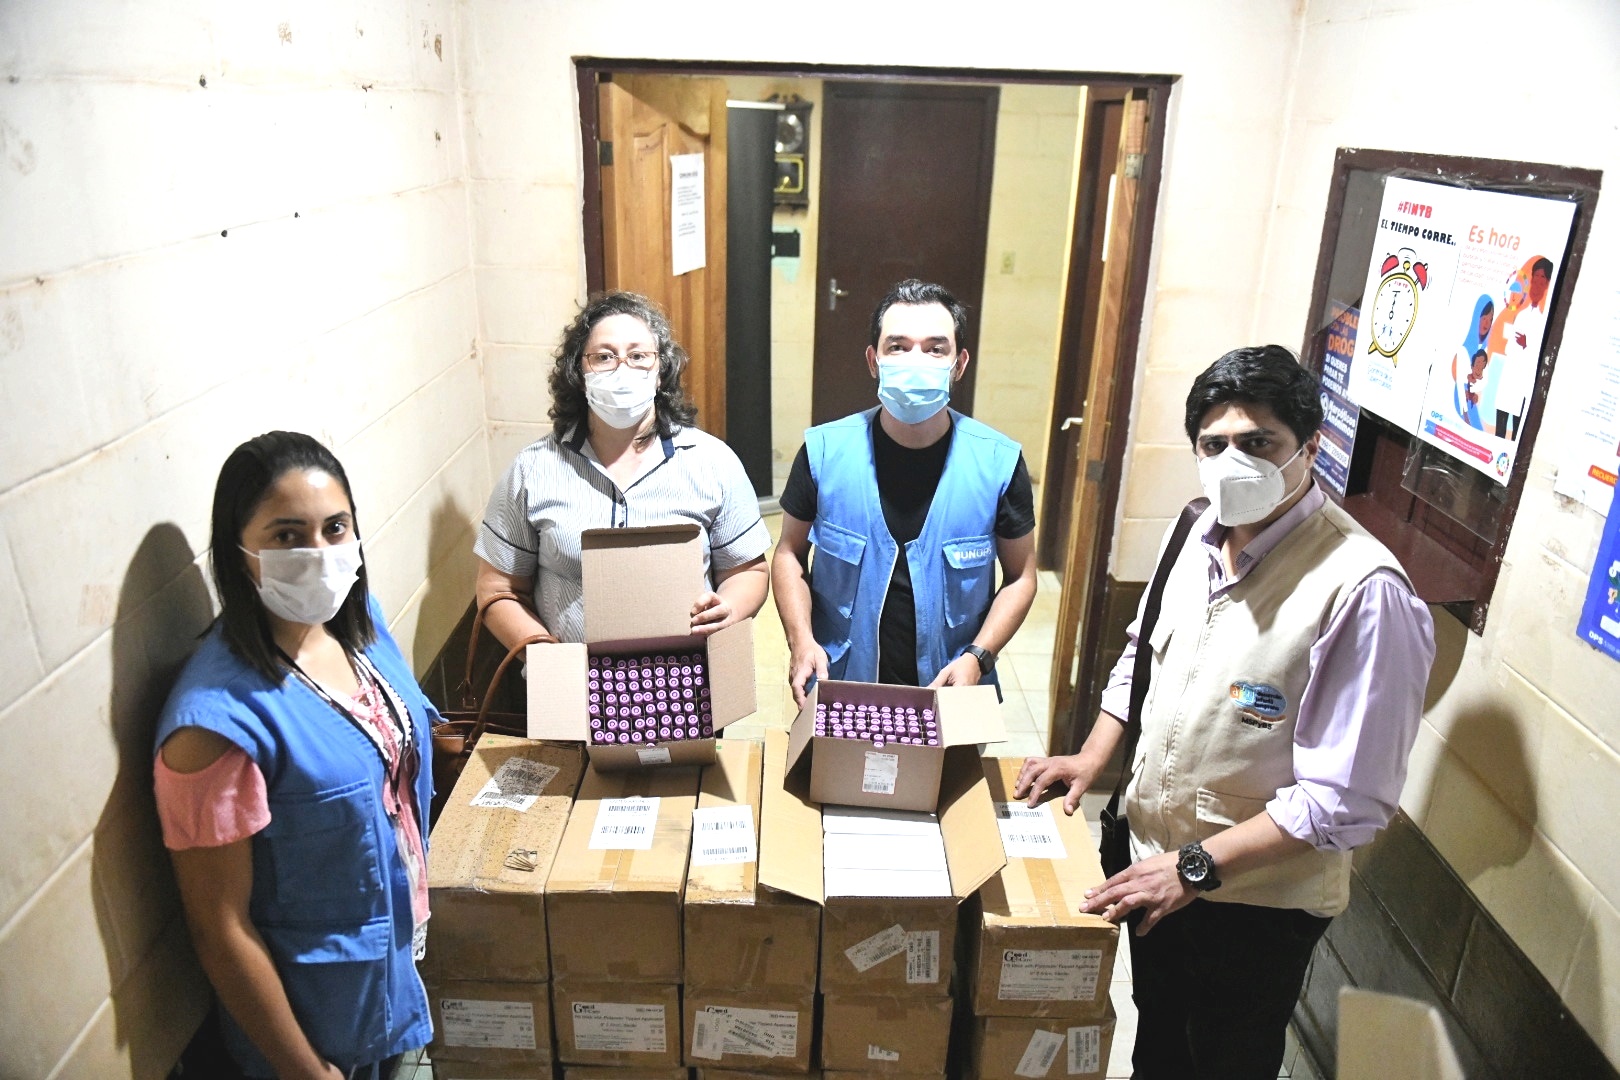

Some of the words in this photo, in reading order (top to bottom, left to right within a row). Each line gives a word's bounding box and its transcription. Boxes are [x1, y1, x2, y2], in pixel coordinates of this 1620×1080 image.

[1397, 201, 1433, 219] #FINTB
[1381, 219, 1389, 230] EL
[1390, 221, 1420, 237] TIEMPO
[1468, 224, 1485, 244] Es
[1488, 227, 1521, 252] hora
[1588, 630, 1604, 646] OPS
